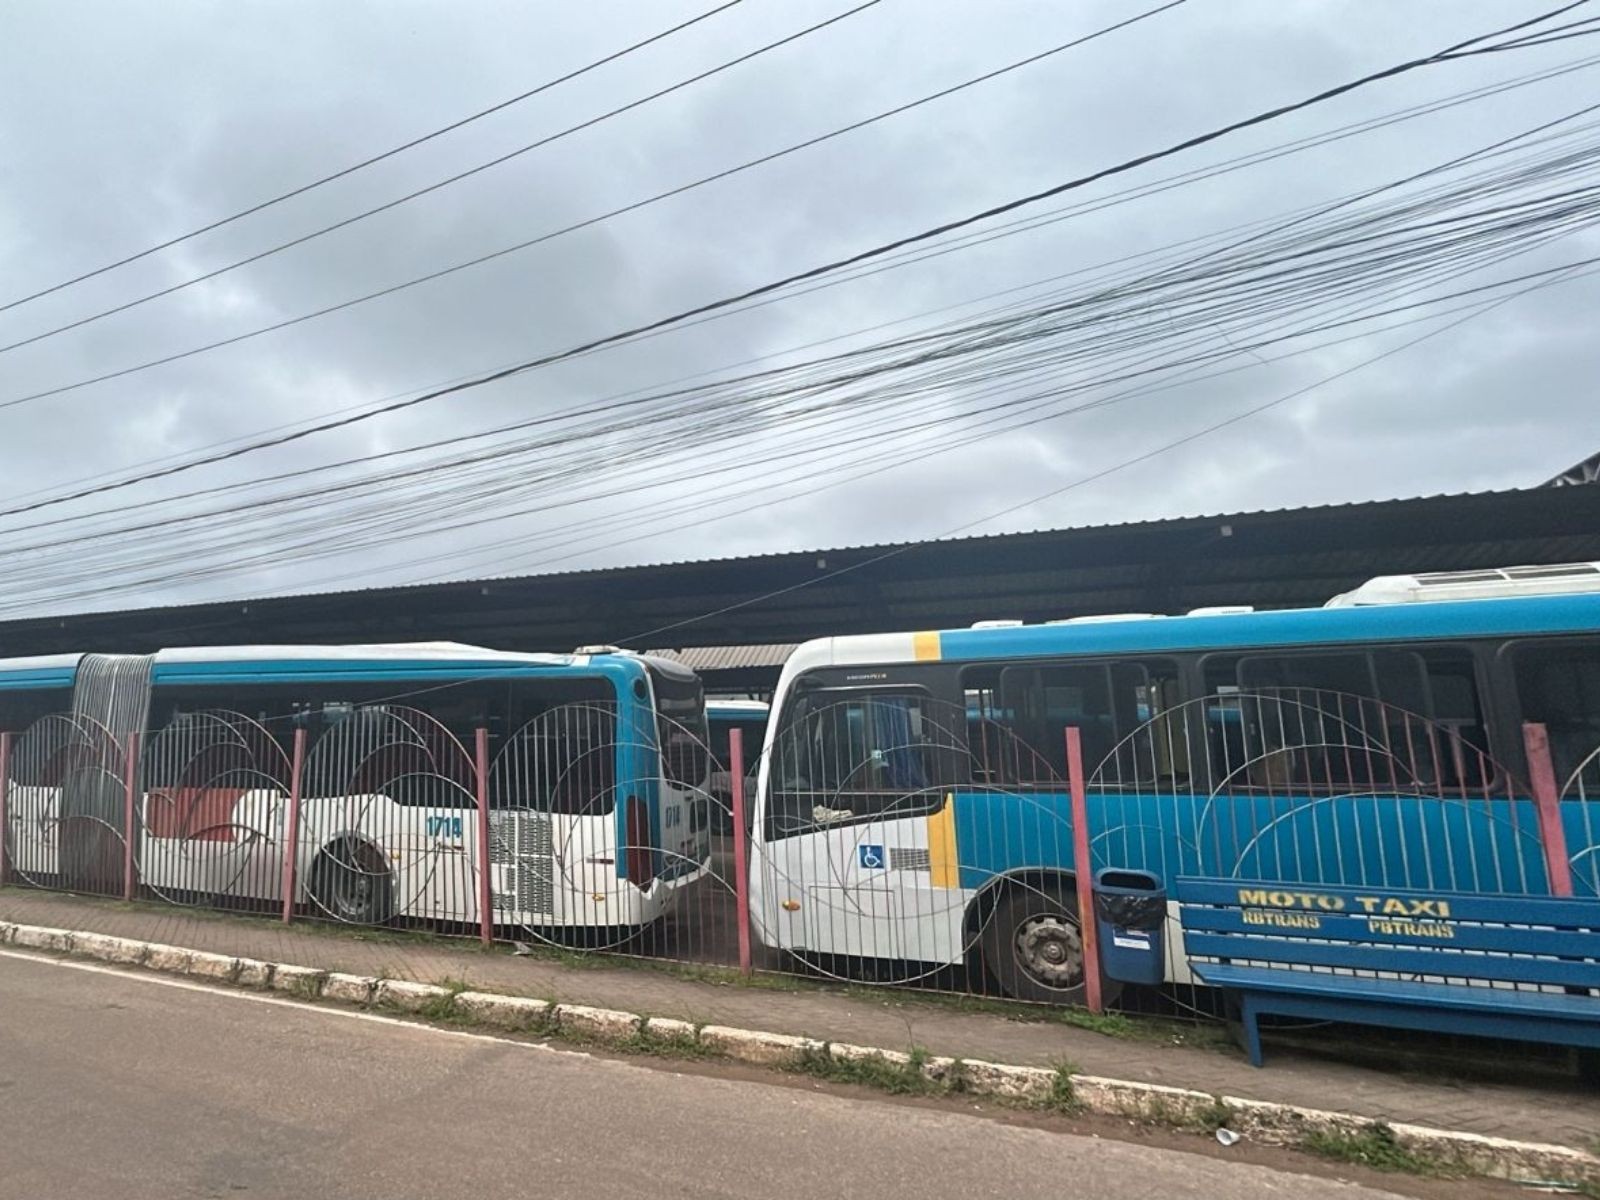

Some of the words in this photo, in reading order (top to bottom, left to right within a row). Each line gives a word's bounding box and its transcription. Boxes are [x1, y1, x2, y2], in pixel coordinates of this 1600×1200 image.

[427, 816, 462, 838] 1714
[1239, 889, 1345, 911] MOTO
[1355, 896, 1450, 918] TAXI
